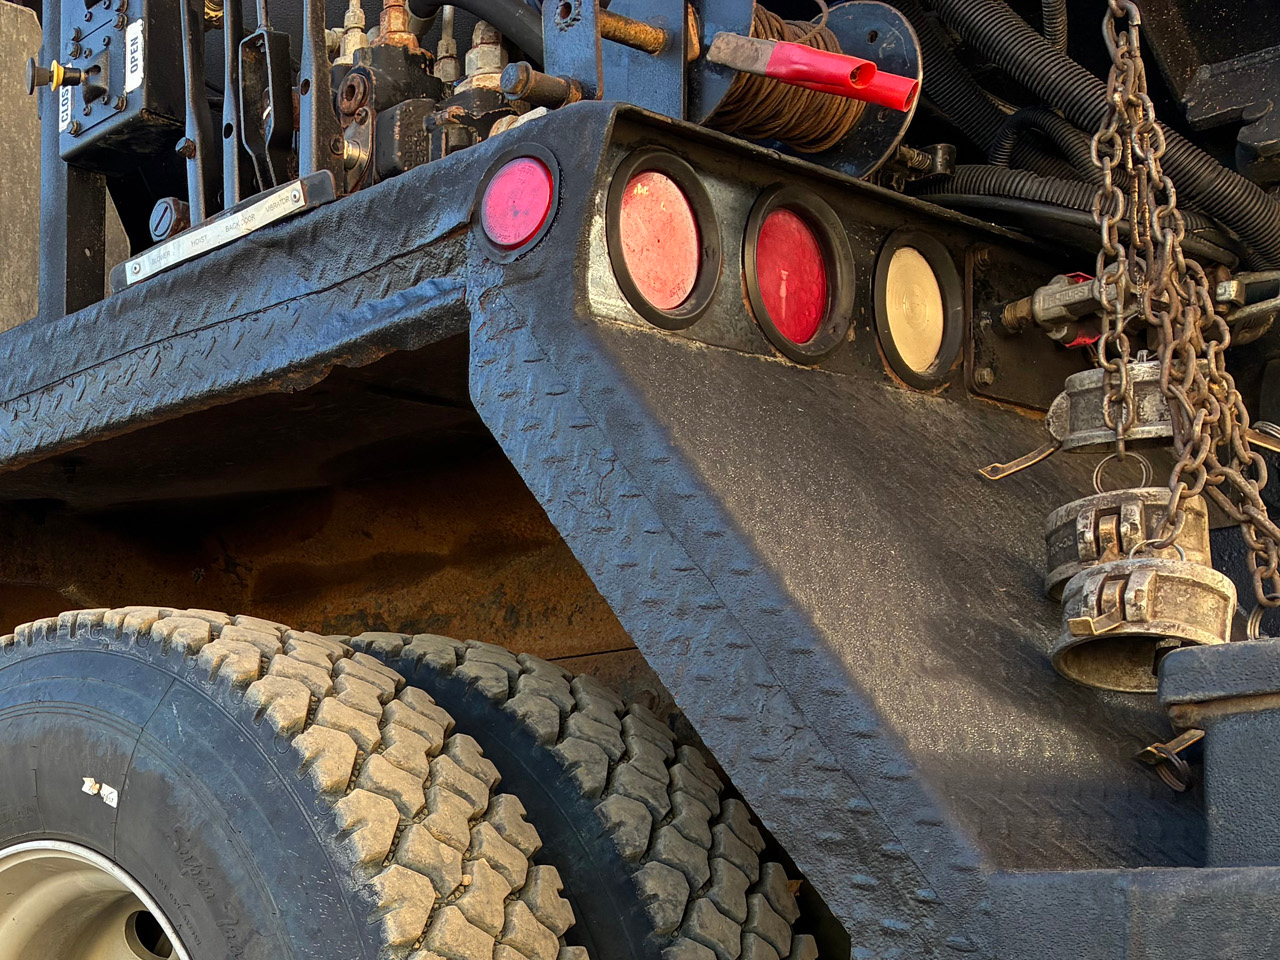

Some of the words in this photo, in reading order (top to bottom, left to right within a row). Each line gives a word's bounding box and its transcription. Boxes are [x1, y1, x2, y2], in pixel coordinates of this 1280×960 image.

[130, 36, 139, 74] OPEN
[190, 234, 208, 247] HOIST
[225, 221, 240, 233] BACK
[240, 213, 256, 227] DOOR
[265, 195, 290, 213] VIBRATOR
